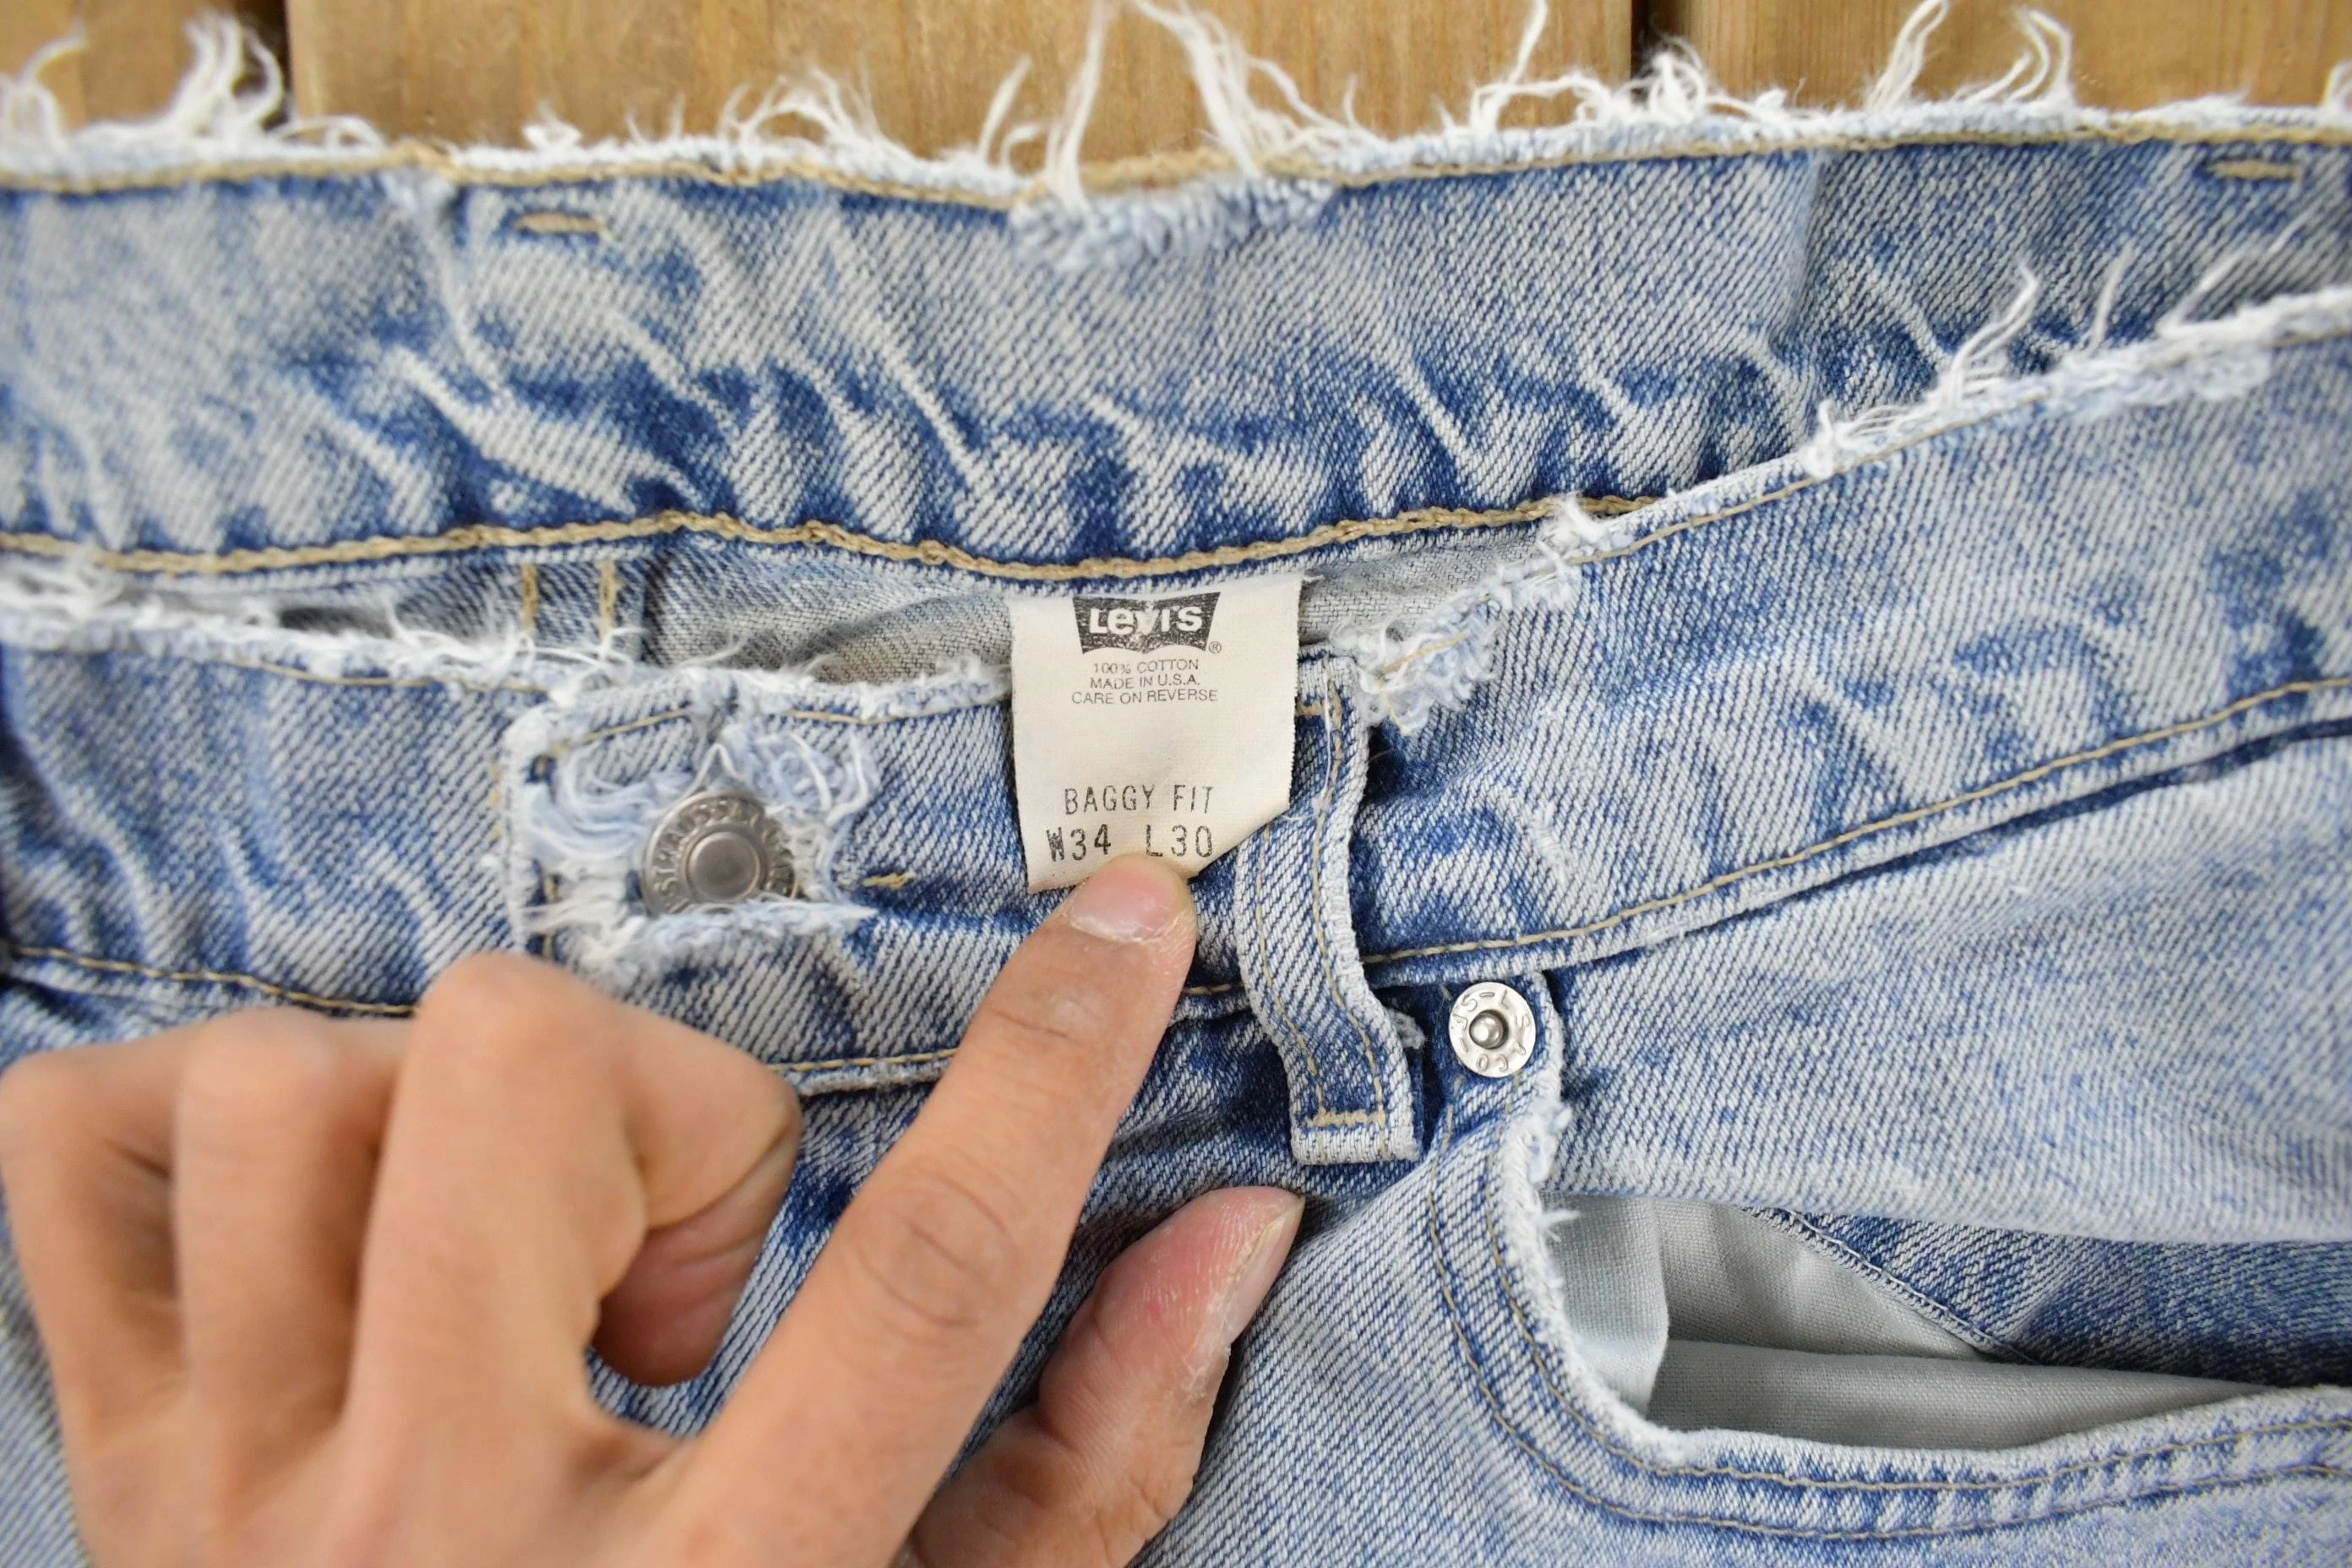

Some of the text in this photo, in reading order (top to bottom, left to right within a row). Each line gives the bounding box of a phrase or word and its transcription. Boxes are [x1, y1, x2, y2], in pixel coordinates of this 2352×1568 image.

[1094, 658, 1200, 675] 100% COTTON
[1090, 673, 1200, 690] MADE IN U.S.A.
[1071, 689, 1219, 705] CARE ON REVERSE
[1064, 784, 1214, 815] BAGGY FIT
[1046, 824, 1213, 862] W34 L30
